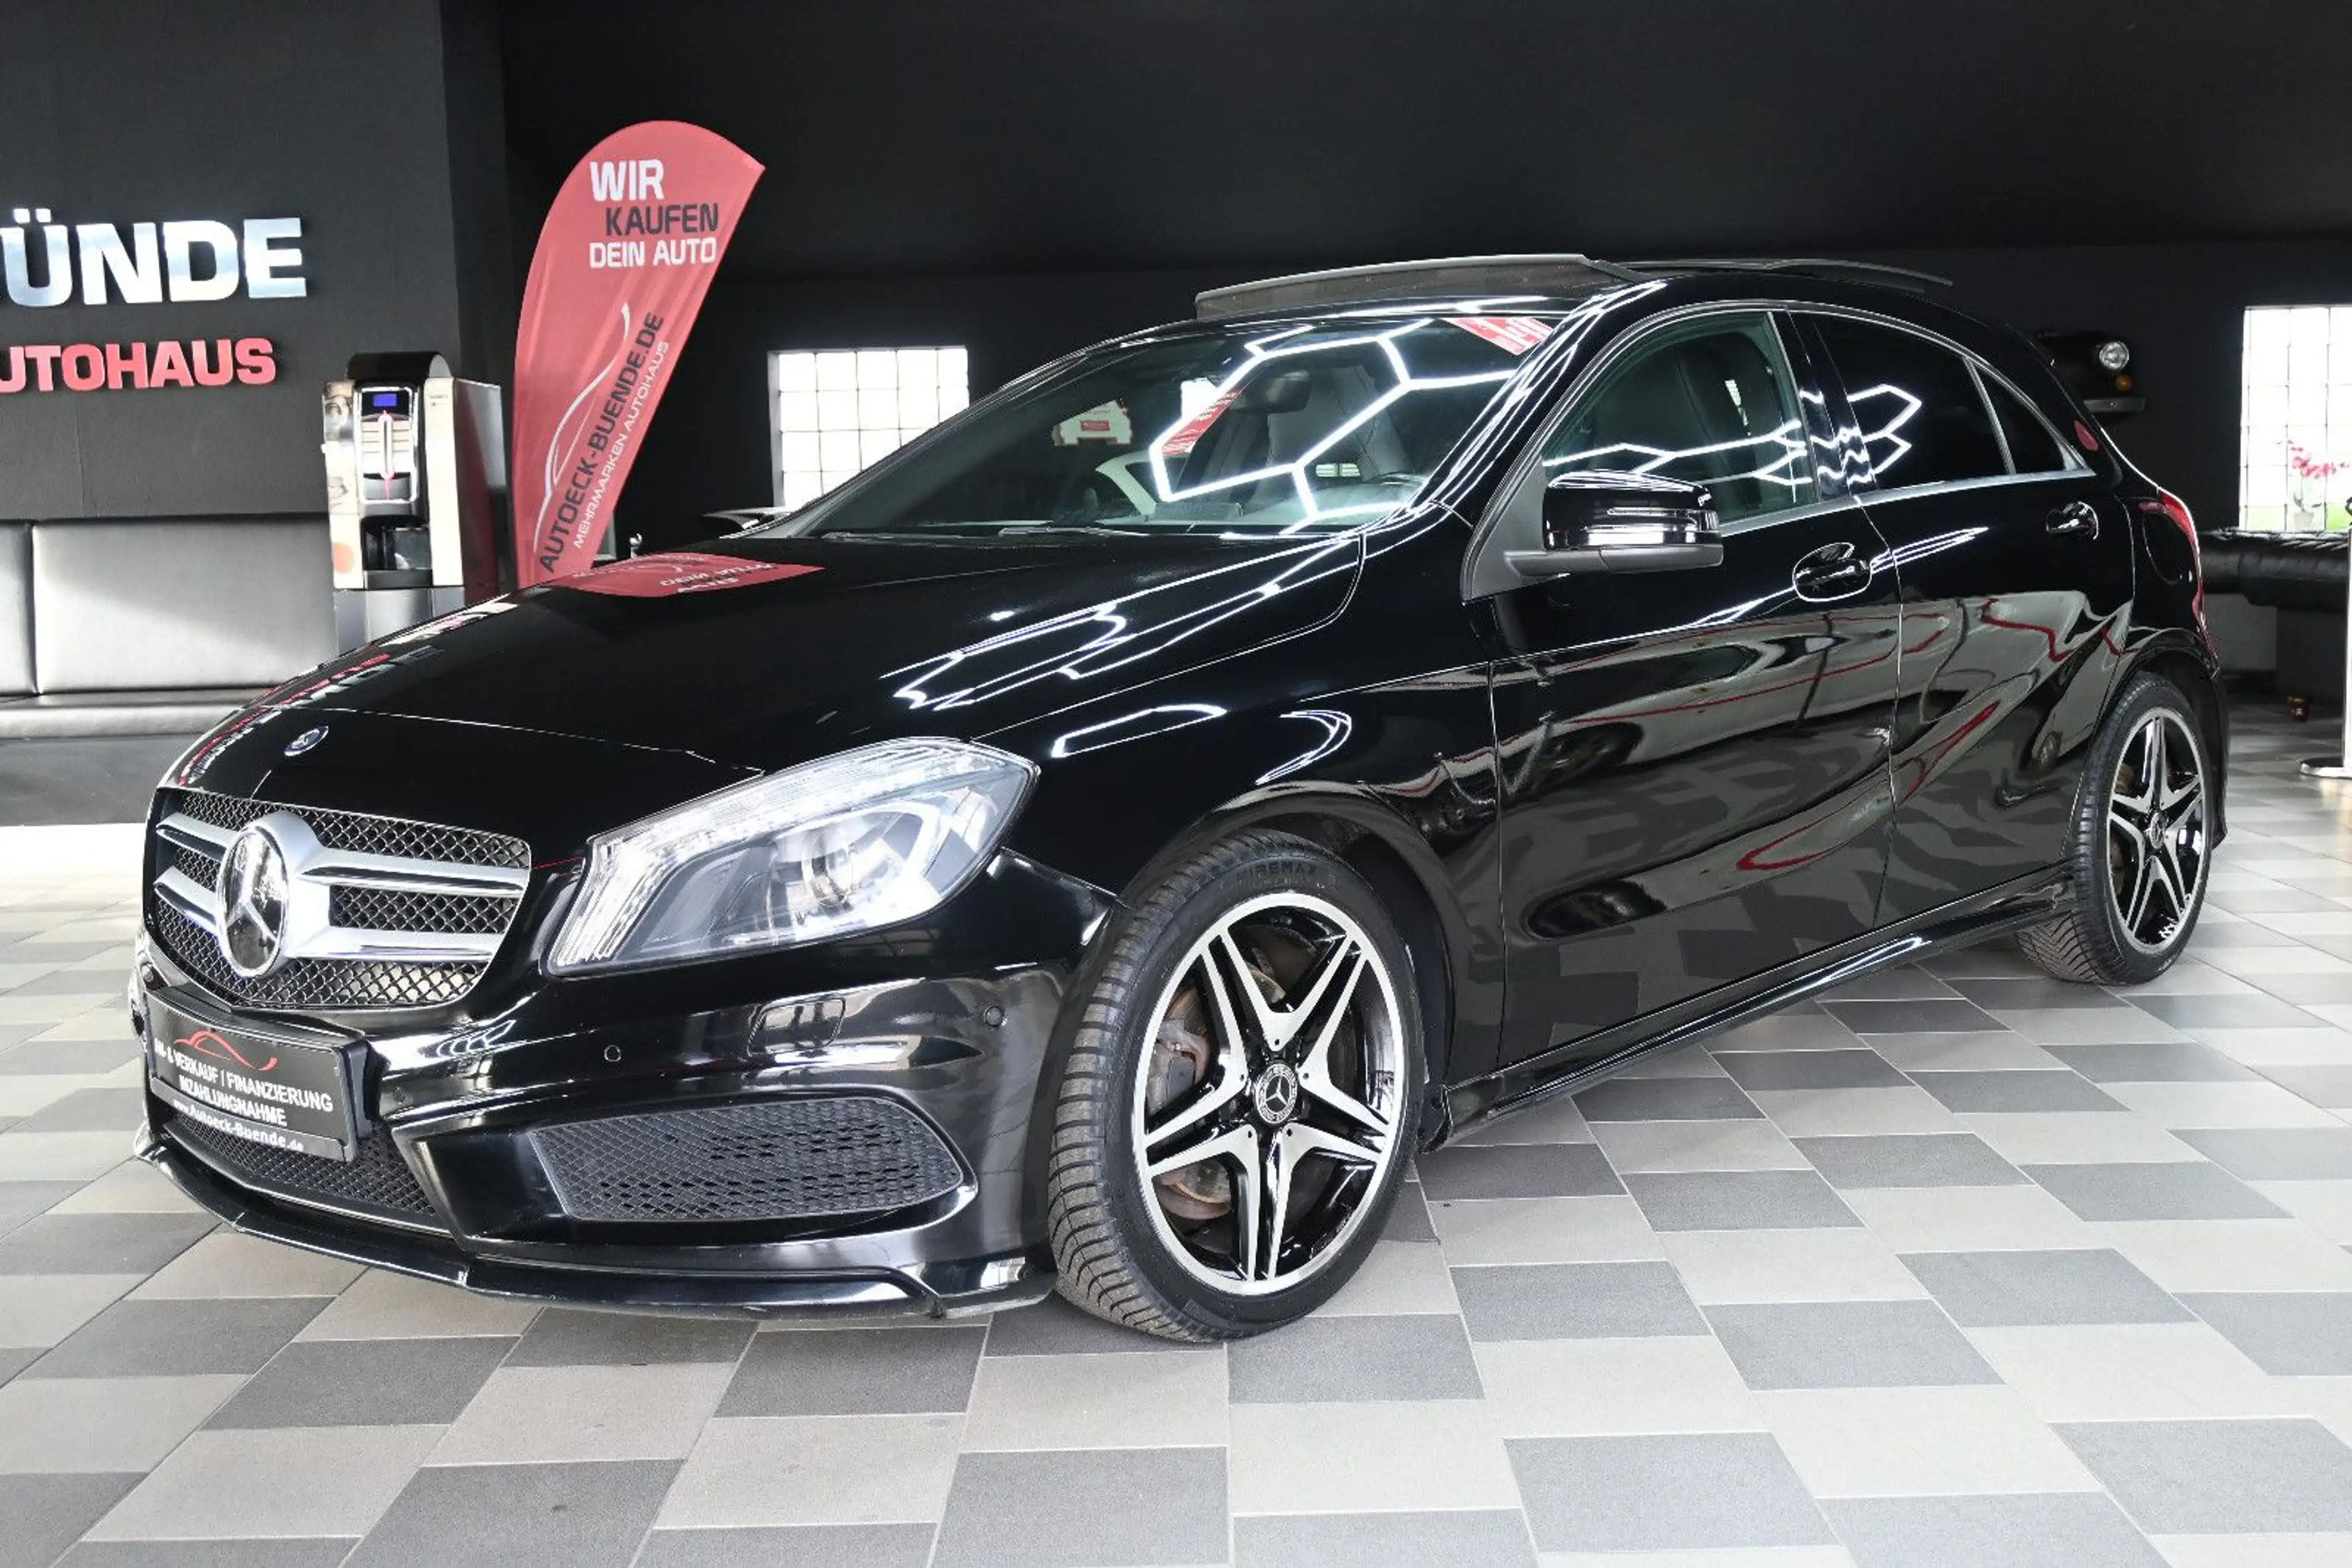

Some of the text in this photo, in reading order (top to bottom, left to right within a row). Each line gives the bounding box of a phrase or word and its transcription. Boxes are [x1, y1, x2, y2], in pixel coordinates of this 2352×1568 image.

[590, 159, 664, 201] WIR
[606, 203, 718, 236] KAUFEN
[0, 208, 306, 307] ÜNDE
[589, 236, 717, 268] DEIN AUTO
[540, 312, 664, 574] AUTOECK-BUENDE.DE
[573, 340, 669, 549] MEHRMARKEN AUTOHAUS
[173, 1049, 219, 1084] VERKAUF
[225, 1071, 333, 1112] FINANZIERUNG
